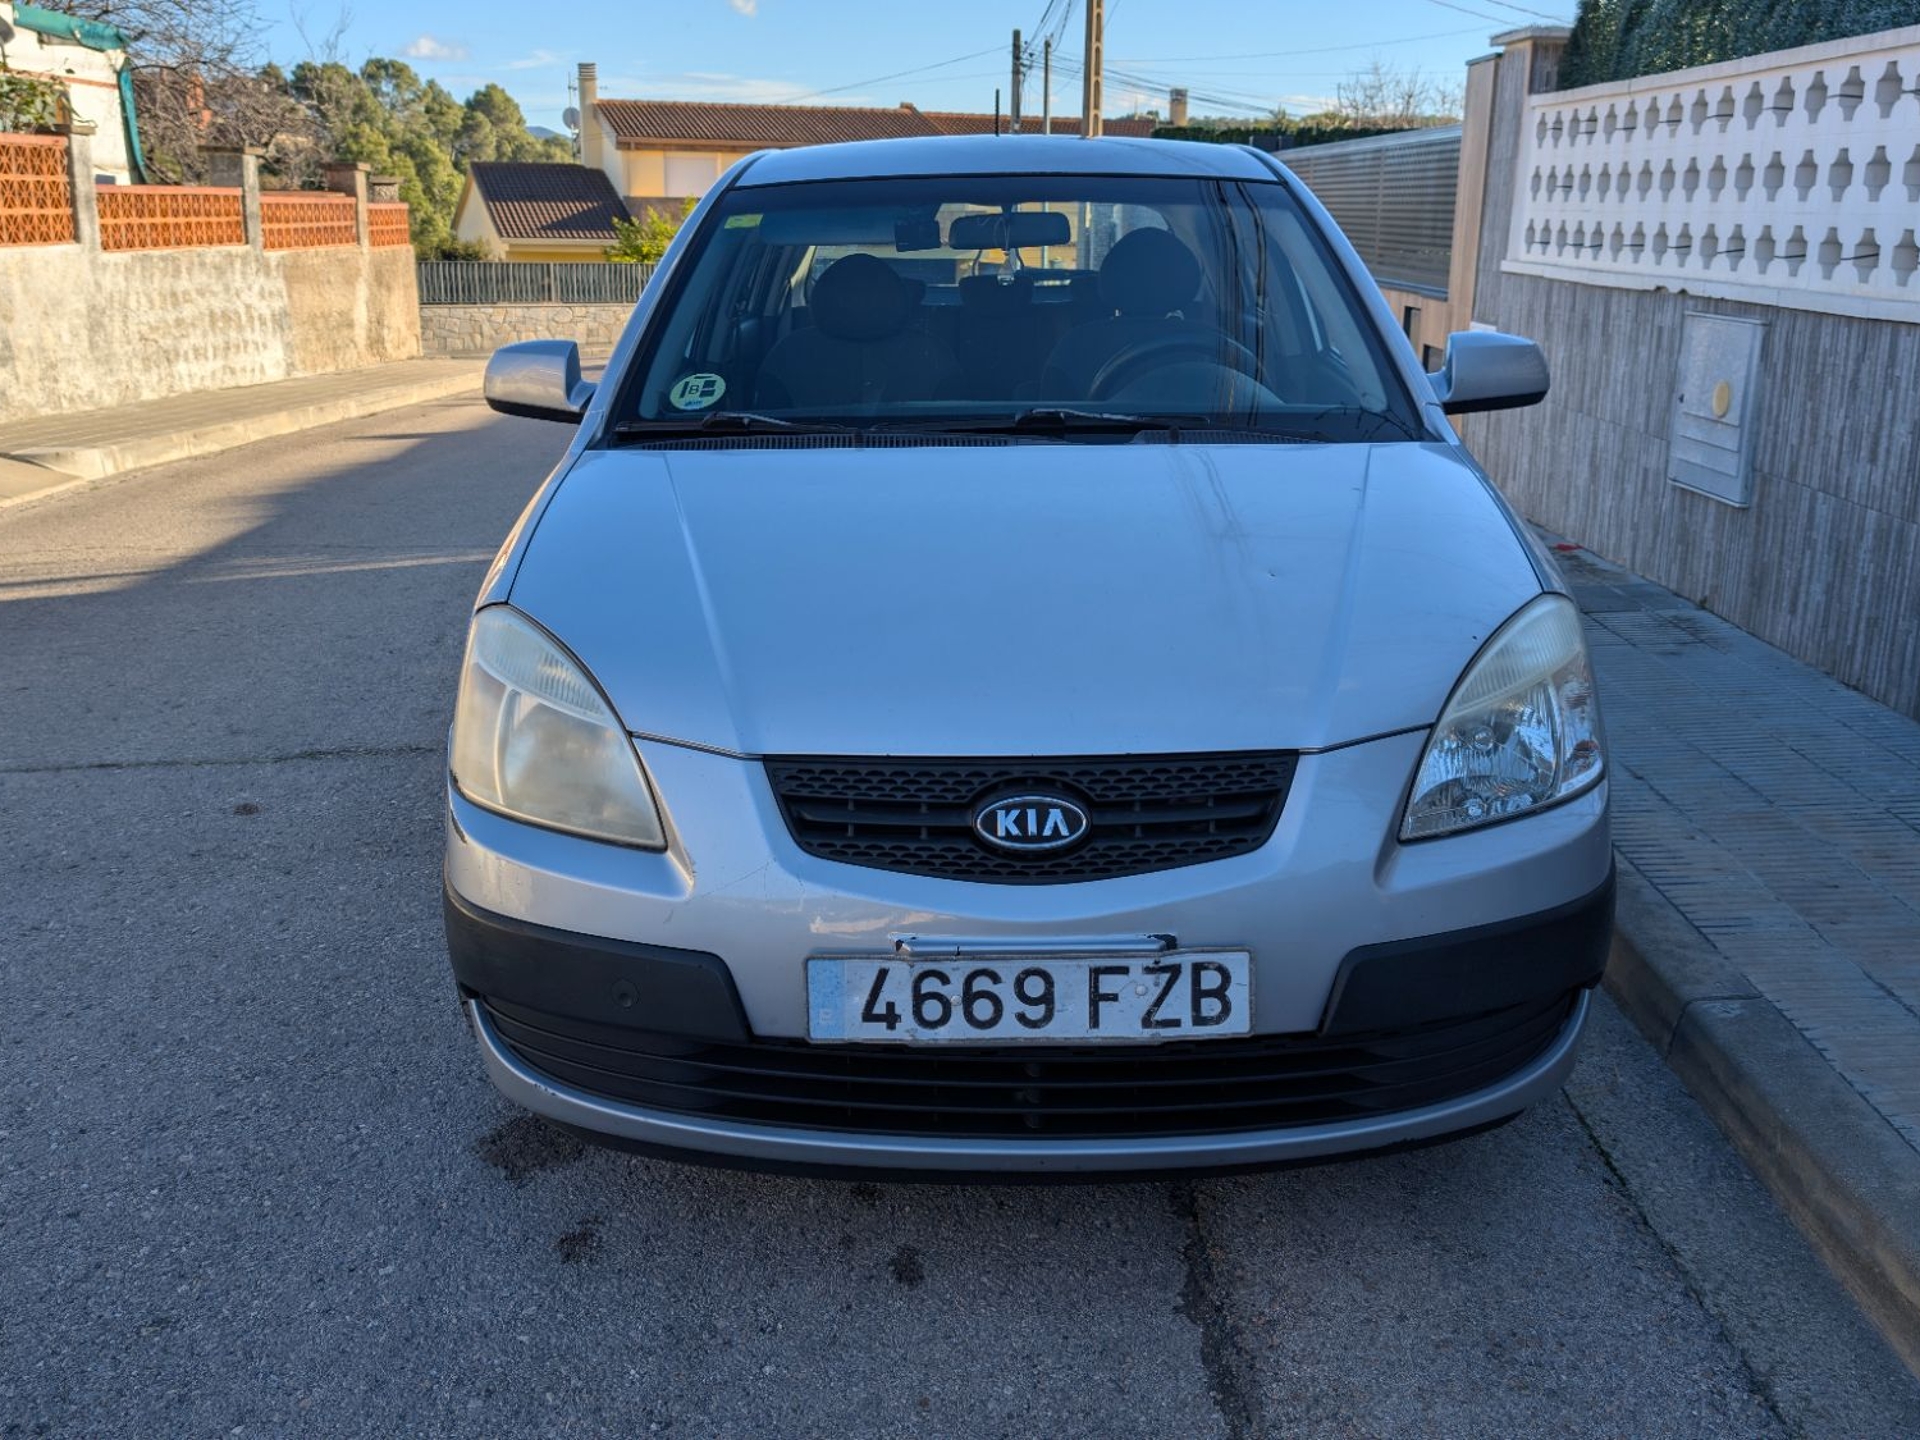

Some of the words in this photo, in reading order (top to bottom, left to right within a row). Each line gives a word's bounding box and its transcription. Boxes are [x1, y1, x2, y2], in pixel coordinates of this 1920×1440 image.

[688, 384, 700, 395] B
[996, 808, 1070, 837] KIA
[861, 967, 1055, 1031] 4669
[1088, 961, 1232, 1030] FZB
